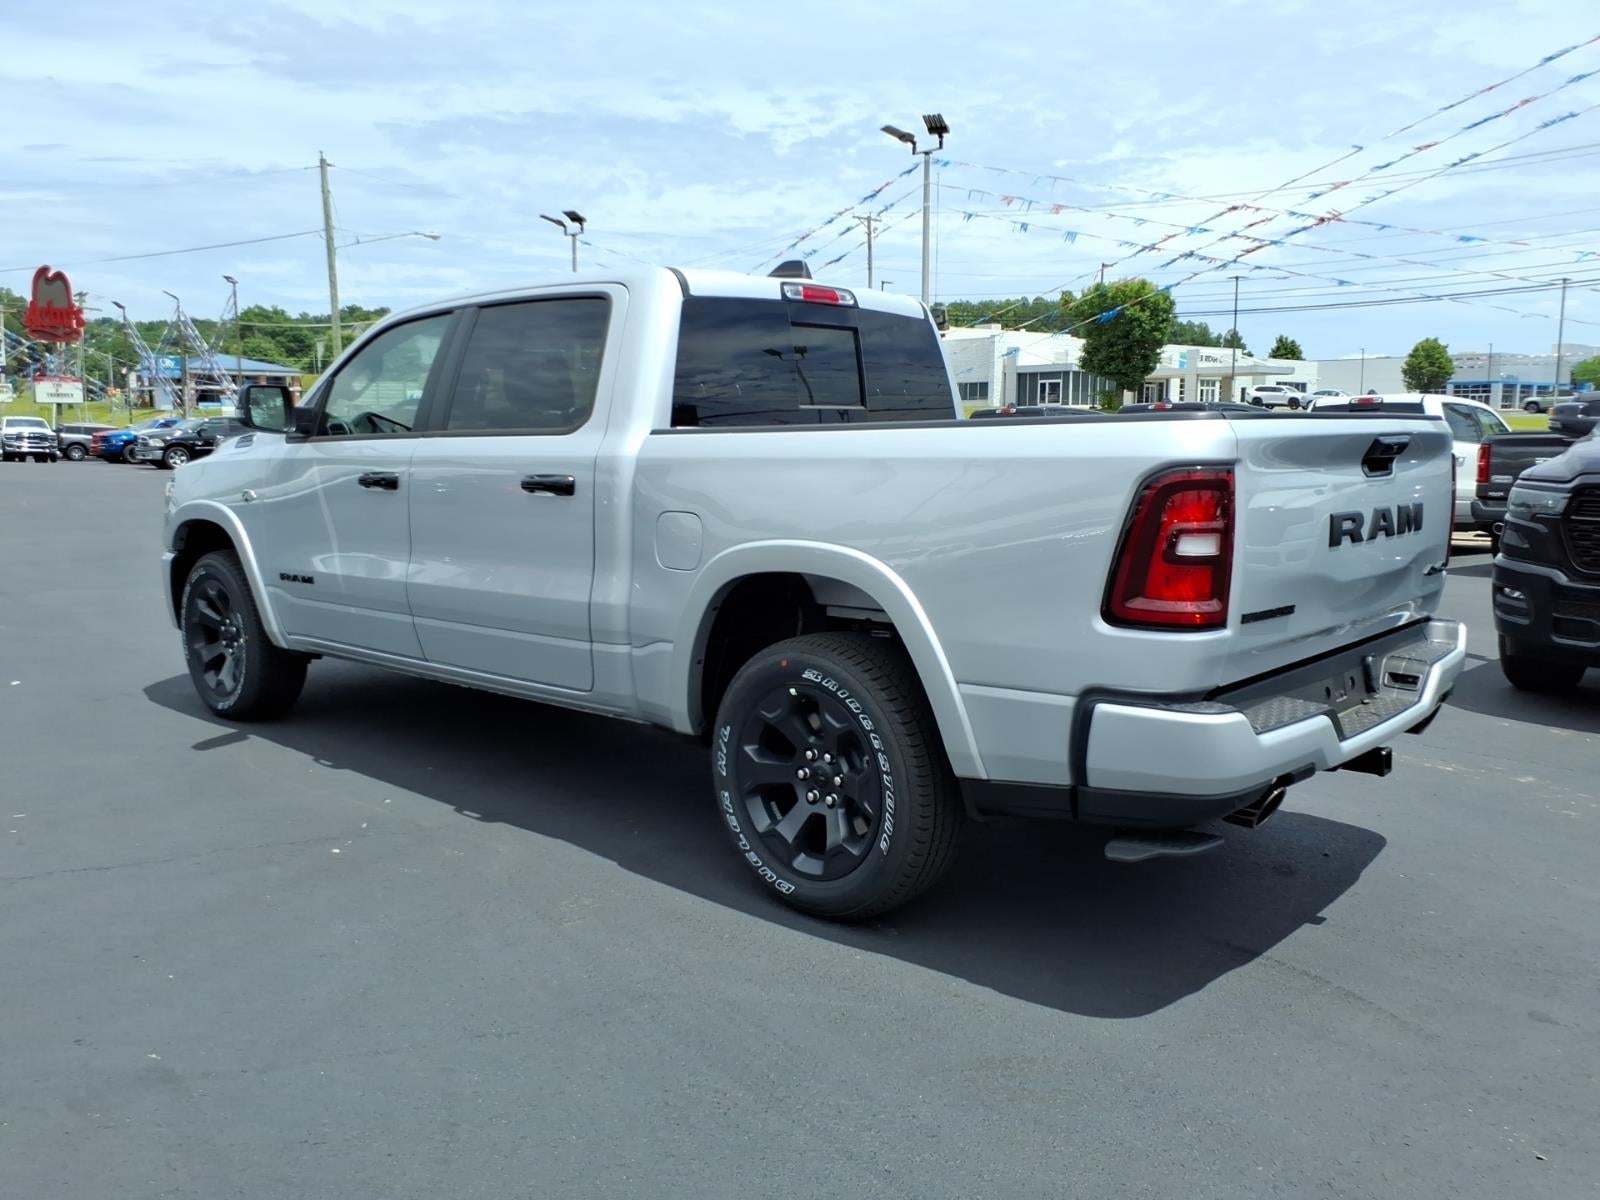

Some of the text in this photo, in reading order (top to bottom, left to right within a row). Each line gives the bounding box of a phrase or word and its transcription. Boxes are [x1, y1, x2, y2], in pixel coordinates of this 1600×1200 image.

[1328, 502, 1424, 548] RAM
[279, 572, 315, 585] RAM
[802, 668, 895, 856] BRIDGESTONE
[720, 790, 796, 894] DUELER
